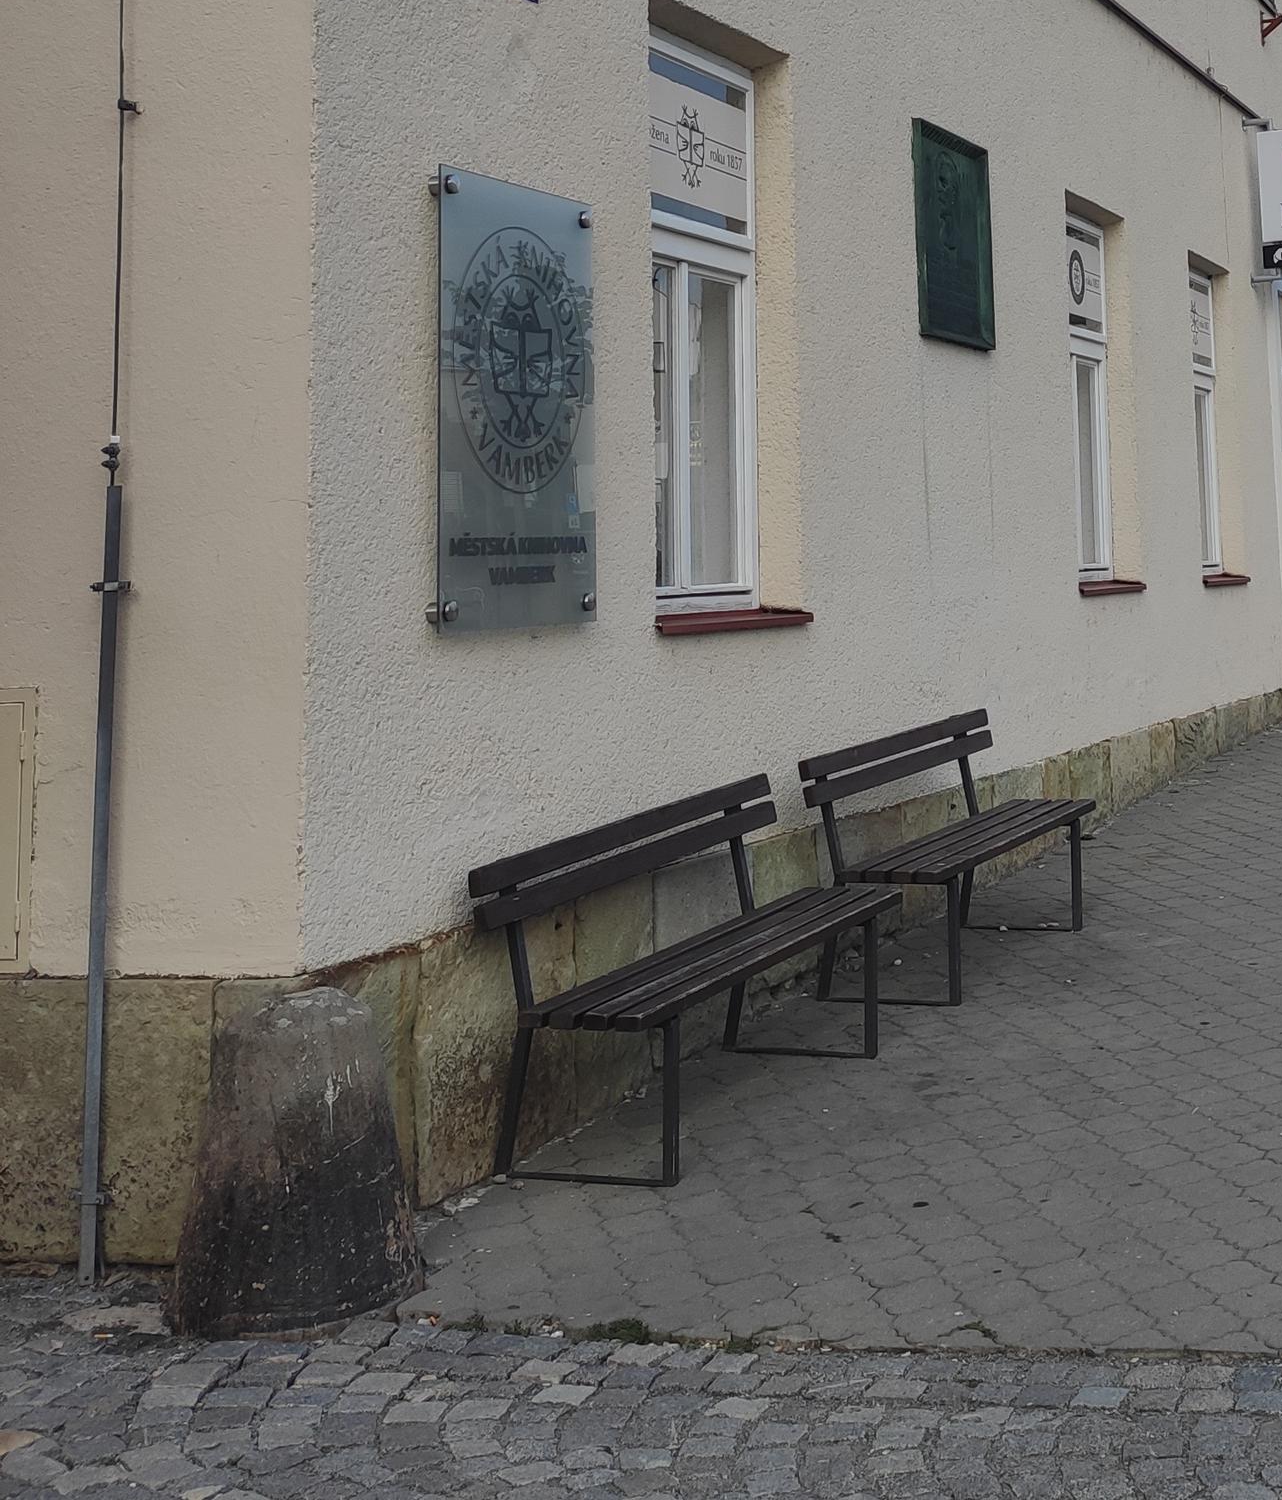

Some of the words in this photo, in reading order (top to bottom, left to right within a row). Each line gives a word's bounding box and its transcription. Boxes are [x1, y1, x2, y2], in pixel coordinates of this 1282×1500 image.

[649, 124, 670, 144] žena
[709, 148, 725, 165] roku
[726, 154, 743, 171] 1857
[479, 422, 569, 485] VAMBERK
